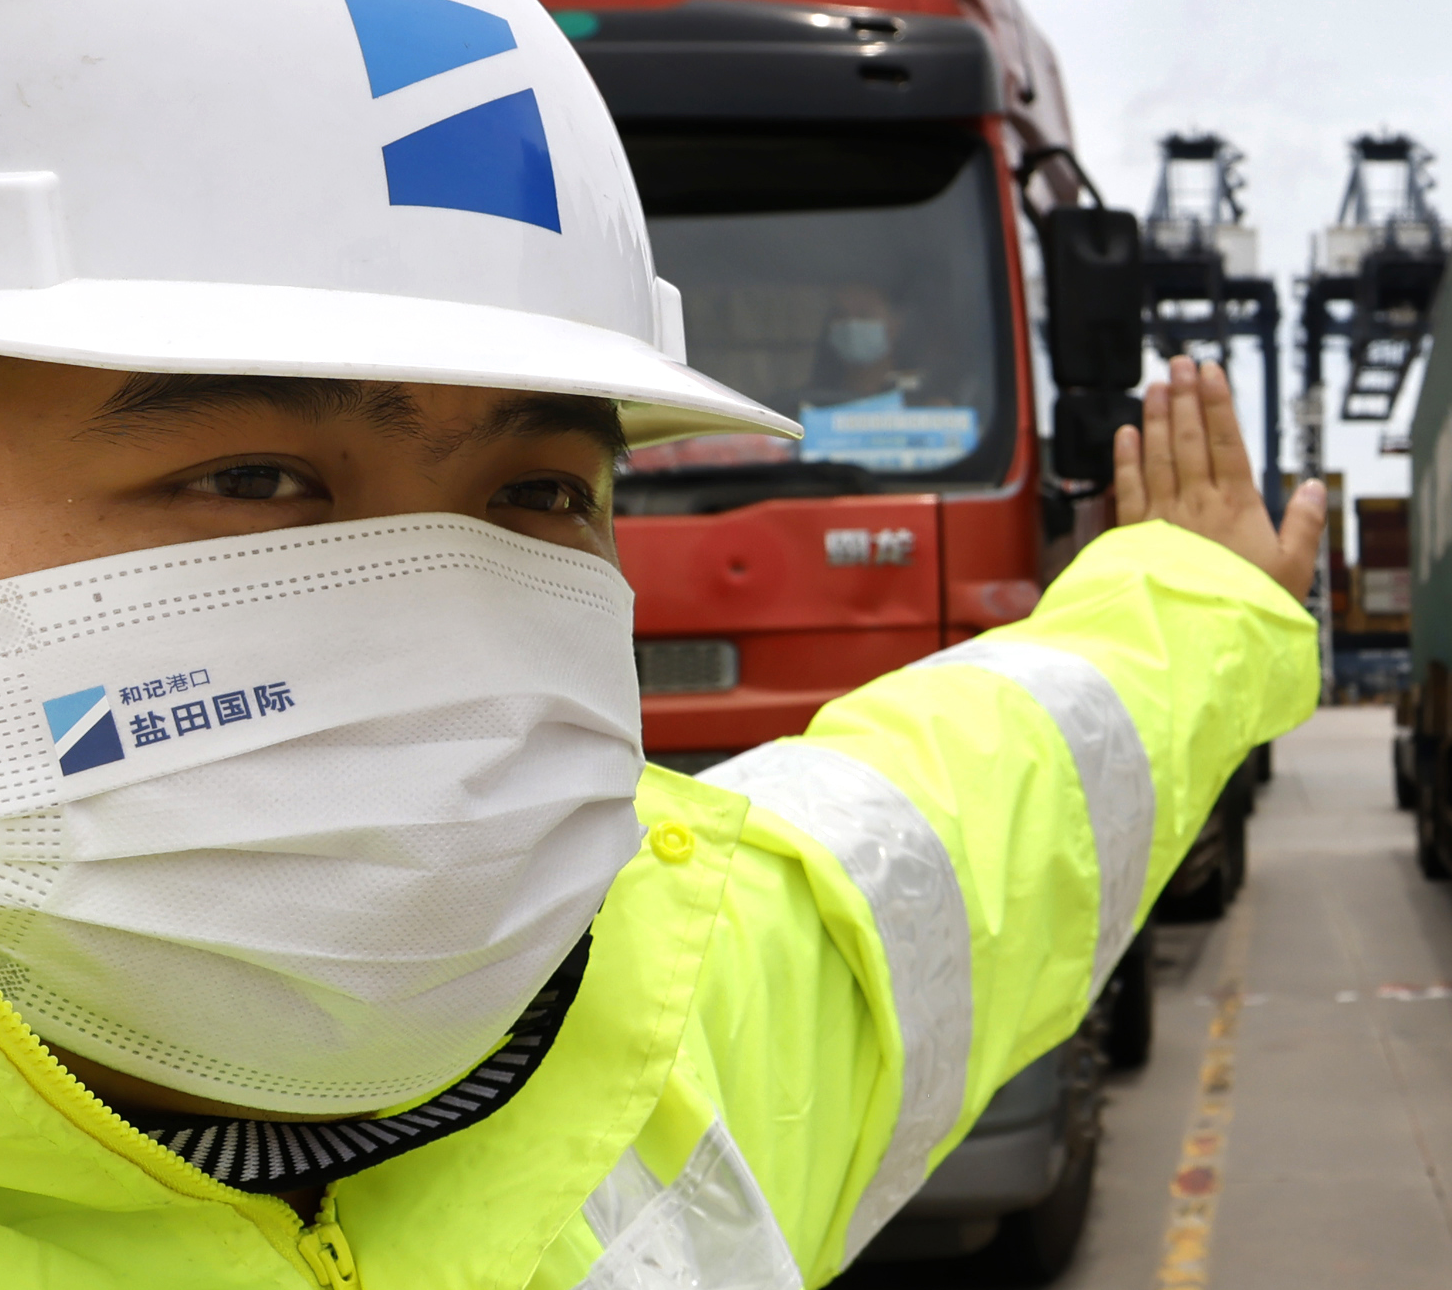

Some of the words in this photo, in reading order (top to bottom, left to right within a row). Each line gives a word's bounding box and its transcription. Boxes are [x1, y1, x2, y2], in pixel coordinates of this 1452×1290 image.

[118, 668, 210, 706] 和记港口
[129, 681, 295, 748] 盐田国际
